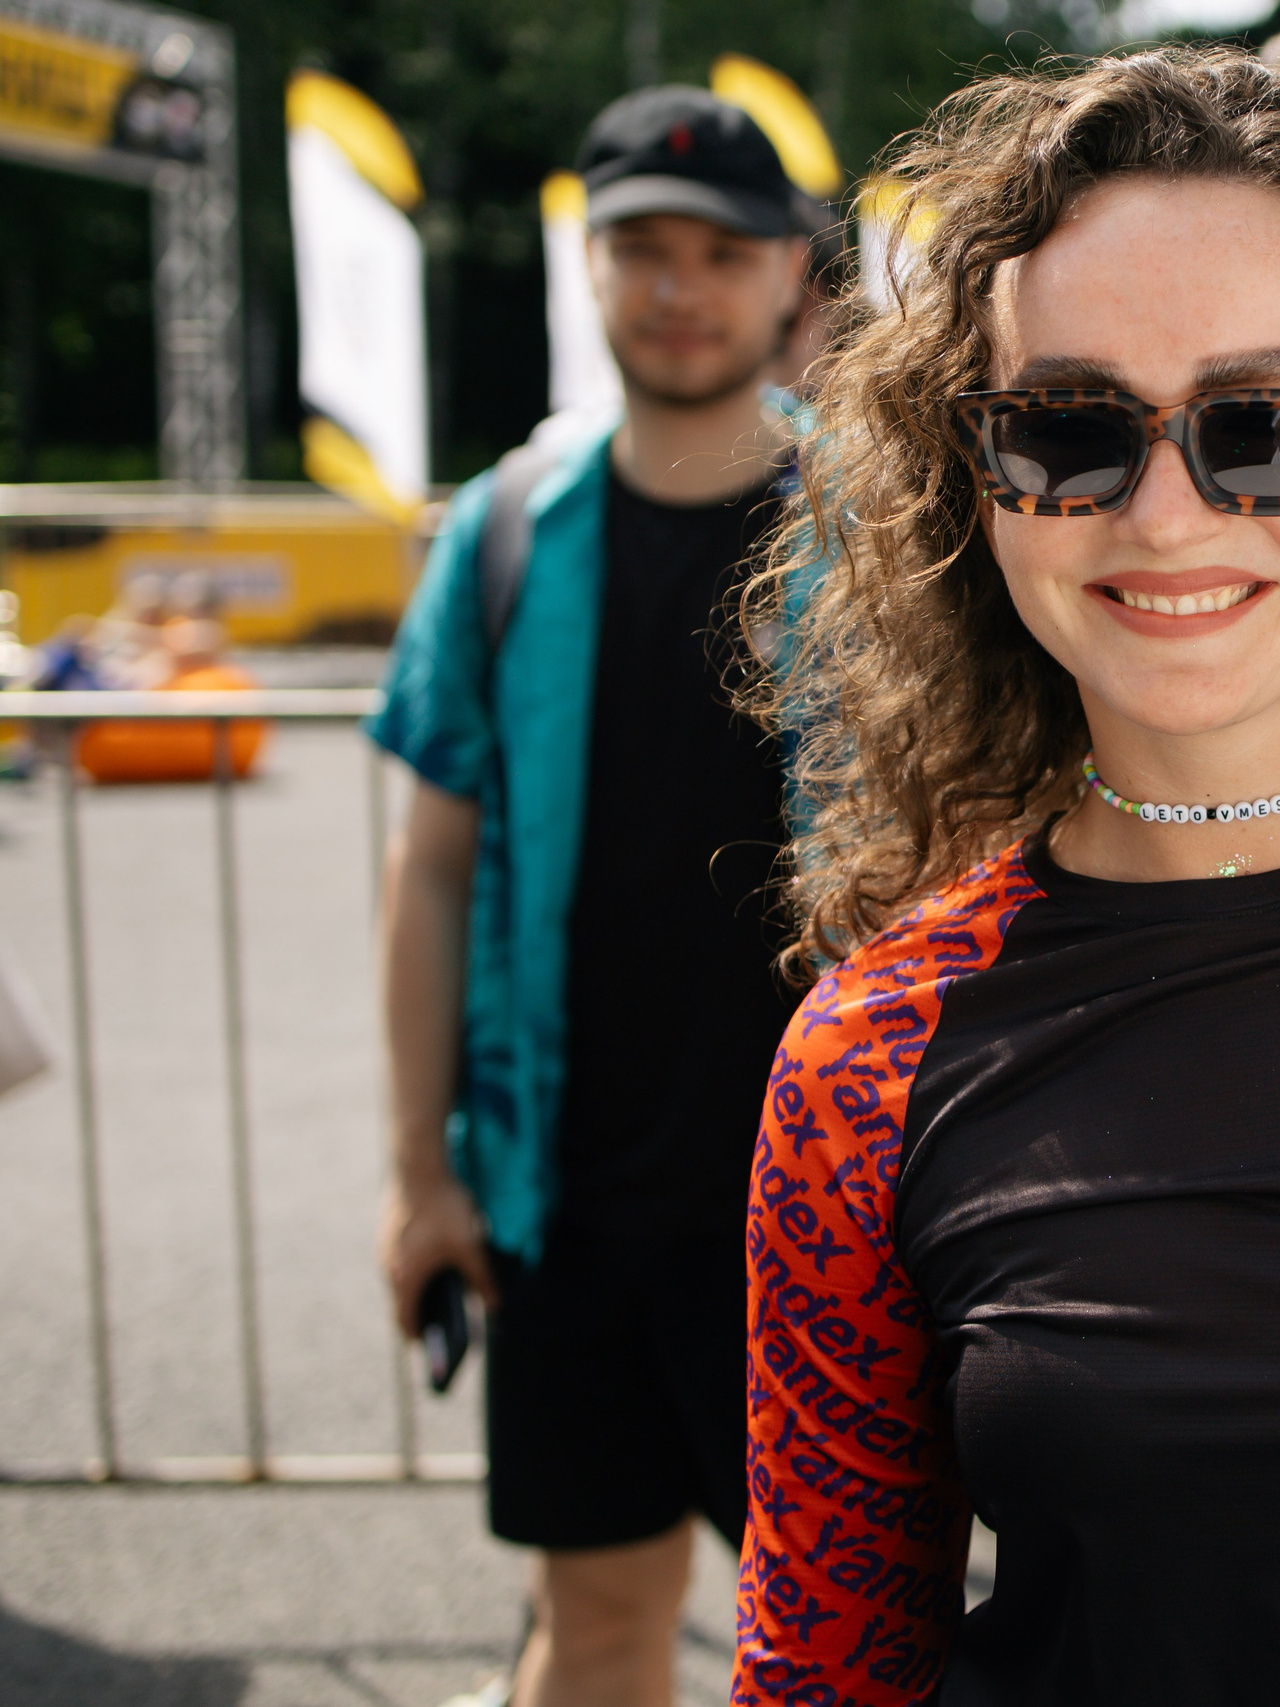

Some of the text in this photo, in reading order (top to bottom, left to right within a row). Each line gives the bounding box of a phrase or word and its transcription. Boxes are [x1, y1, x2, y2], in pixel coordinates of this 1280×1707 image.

[1141, 806, 1203, 822] LETO
[802, 958, 855, 1039] ex
[754, 1294, 944, 1470] Yandex
[773, 1406, 959, 1548] Yandex
